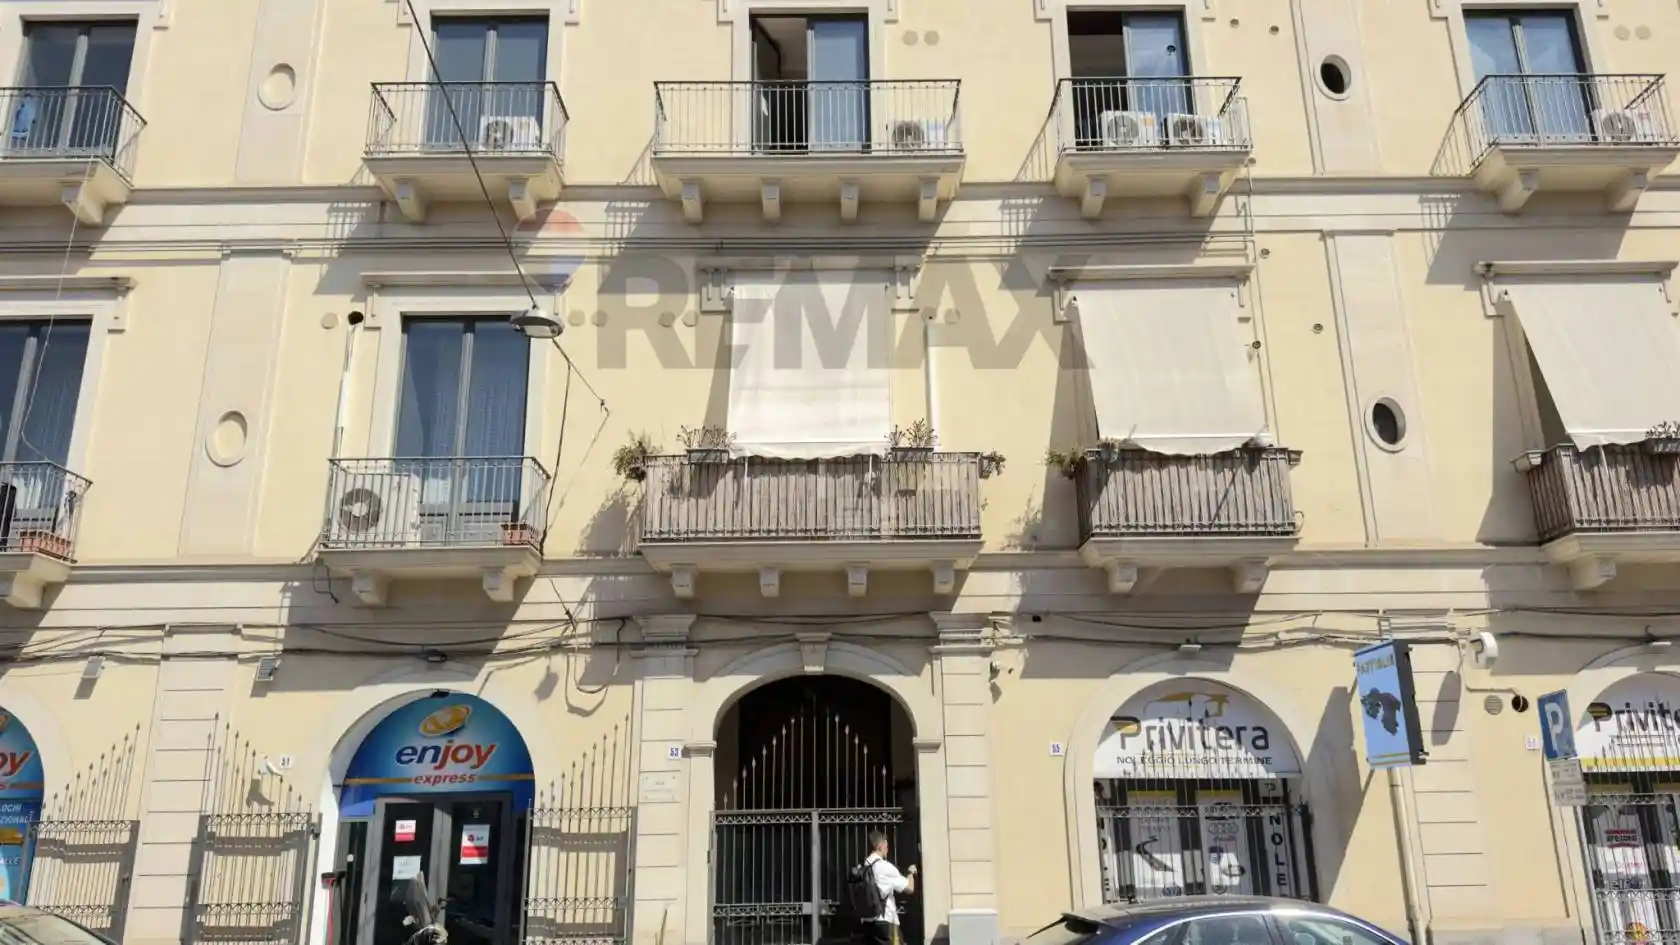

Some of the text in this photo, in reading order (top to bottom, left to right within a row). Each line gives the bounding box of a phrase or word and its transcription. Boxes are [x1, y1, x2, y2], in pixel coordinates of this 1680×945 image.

[1110, 715, 1270, 750] Privitera
[1545, 702, 1564, 756] P
[395, 741, 497, 770] enjoy
[670, 747, 679, 757] 53
[1221, 755, 1273, 766] TERMINE
[413, 773, 477, 785] express
[1269, 815, 1289, 897] NOLE
